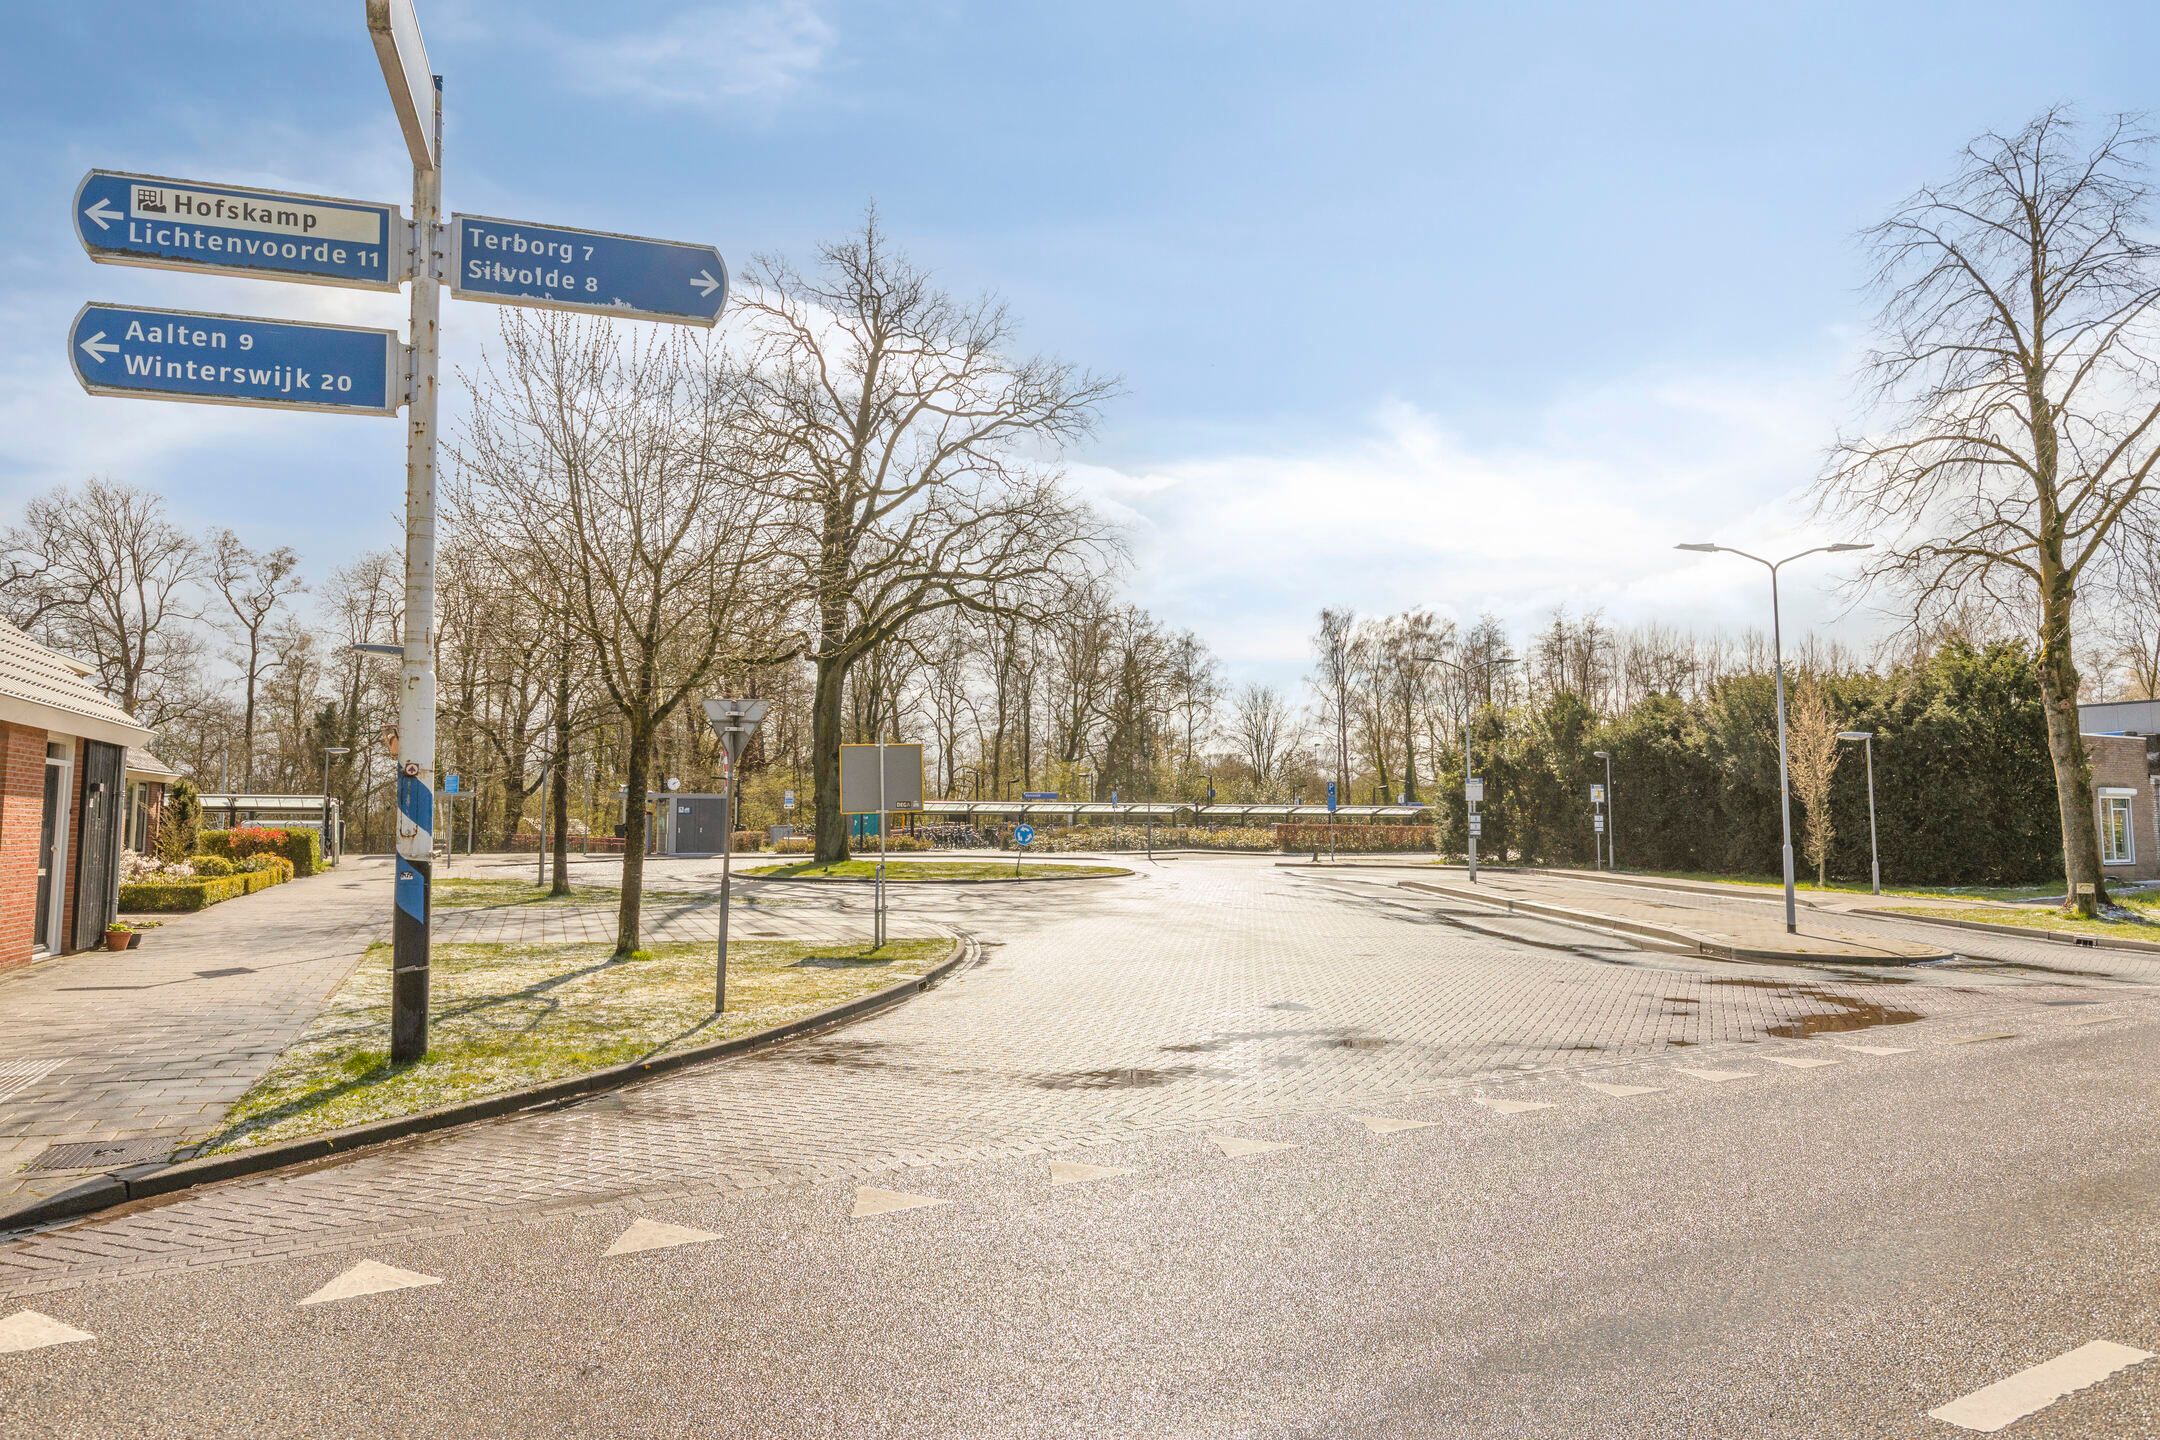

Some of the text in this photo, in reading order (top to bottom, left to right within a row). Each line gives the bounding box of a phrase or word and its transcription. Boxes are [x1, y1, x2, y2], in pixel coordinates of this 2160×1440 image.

[174, 194, 318, 233] Hofskamp
[129, 222, 380, 268] Lichtenvoorde 11
[468, 227, 595, 264] Terborg 7
[468, 259, 598, 293] Silvolde 8
[125, 320, 254, 351] Aalten 9
[124, 354, 352, 393] Winterswijk 20
